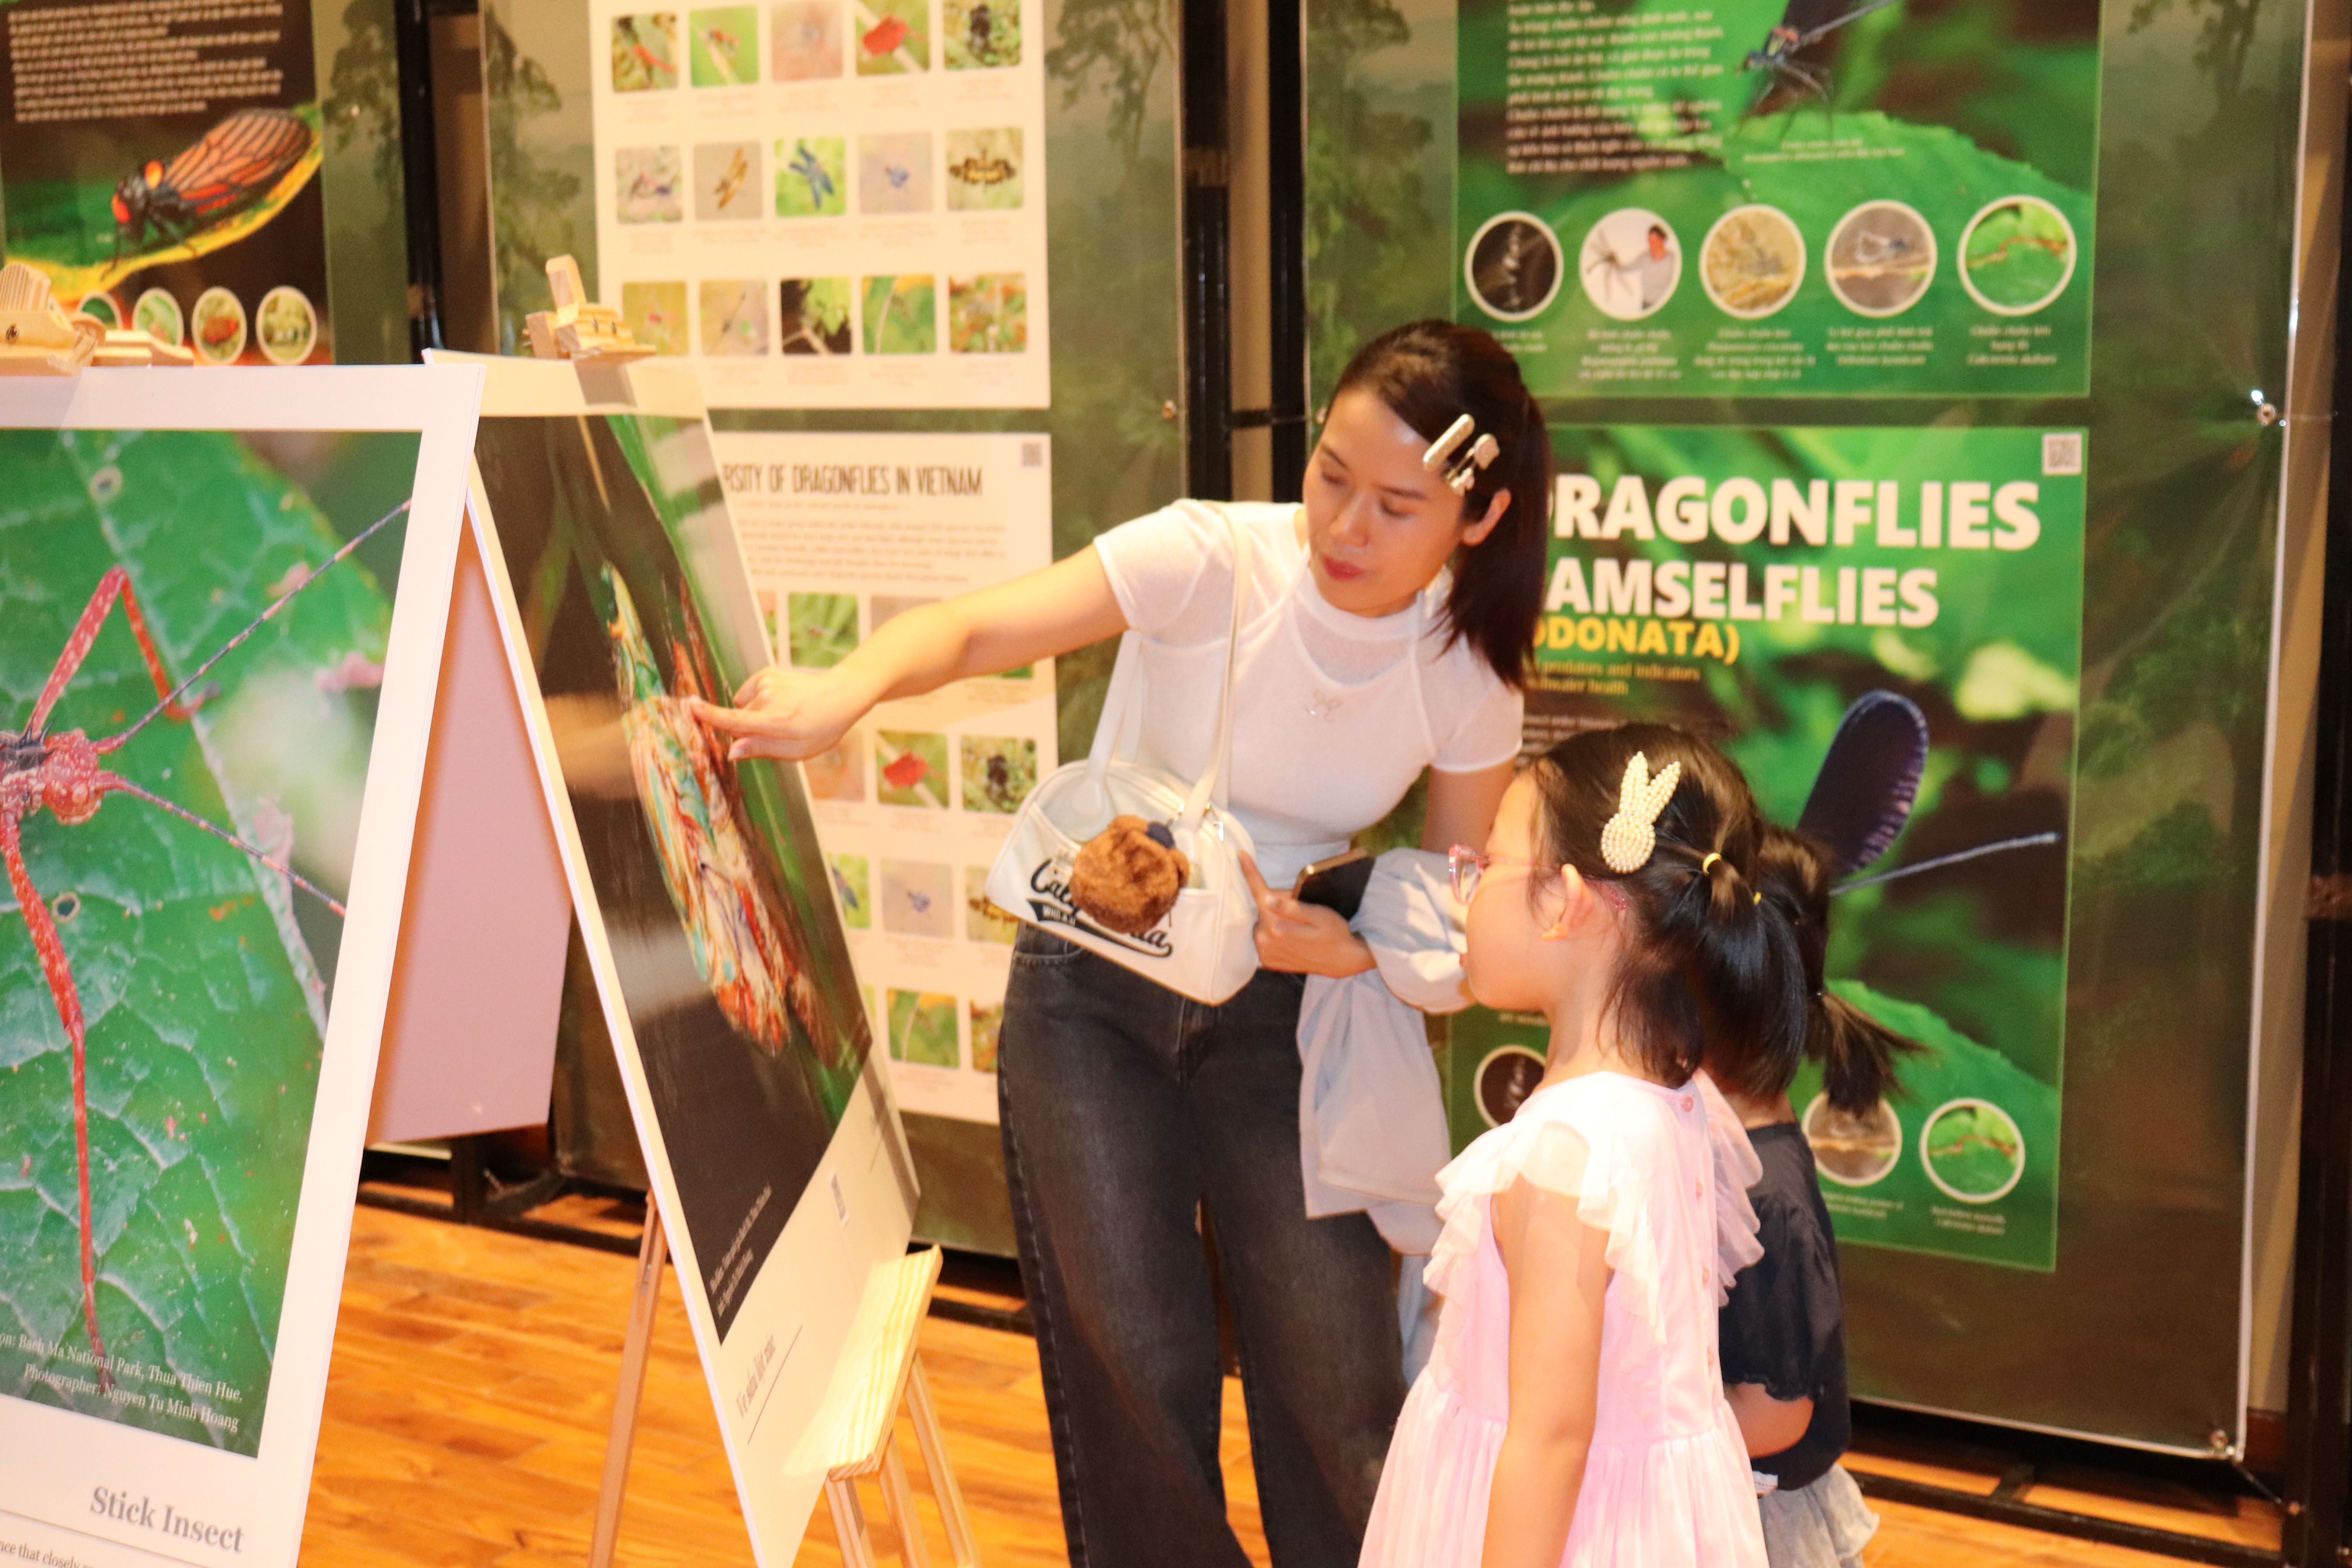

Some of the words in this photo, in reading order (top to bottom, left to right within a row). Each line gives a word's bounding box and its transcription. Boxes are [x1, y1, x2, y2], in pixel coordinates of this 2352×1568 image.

[723, 463, 762, 493] RSITY
[768, 464, 785, 493] OF
[792, 464, 890, 495] DRAGONFLIES
[897, 465, 910, 494] IN
[915, 465, 983, 495] VIETNAM
[1548, 474, 2041, 551] RAGONFLIES
[1544, 557, 1940, 628] AMSELFLIES
[1607, 663, 1633, 677] and
[19, 1334, 44, 1354] Bach
[47, 1340, 64, 1359] Ma
[67, 1342, 114, 1371] National
[117, 1357, 144, 1381] Park,
[148, 1365, 177, 1385] Thua
[180, 1371, 212, 1395] Thien
[24, 1363, 101, 1395] Photographer:
[103, 1382, 146, 1407] Nguyen
[149, 1393, 164, 1411] Tu
[167, 1398, 197, 1420] Minh
[200, 1406, 239, 1435] Hoang
[91, 1486, 157, 1528] Stick
[162, 1504, 244, 1553] Insect
[18, 1543, 40, 1561] that
